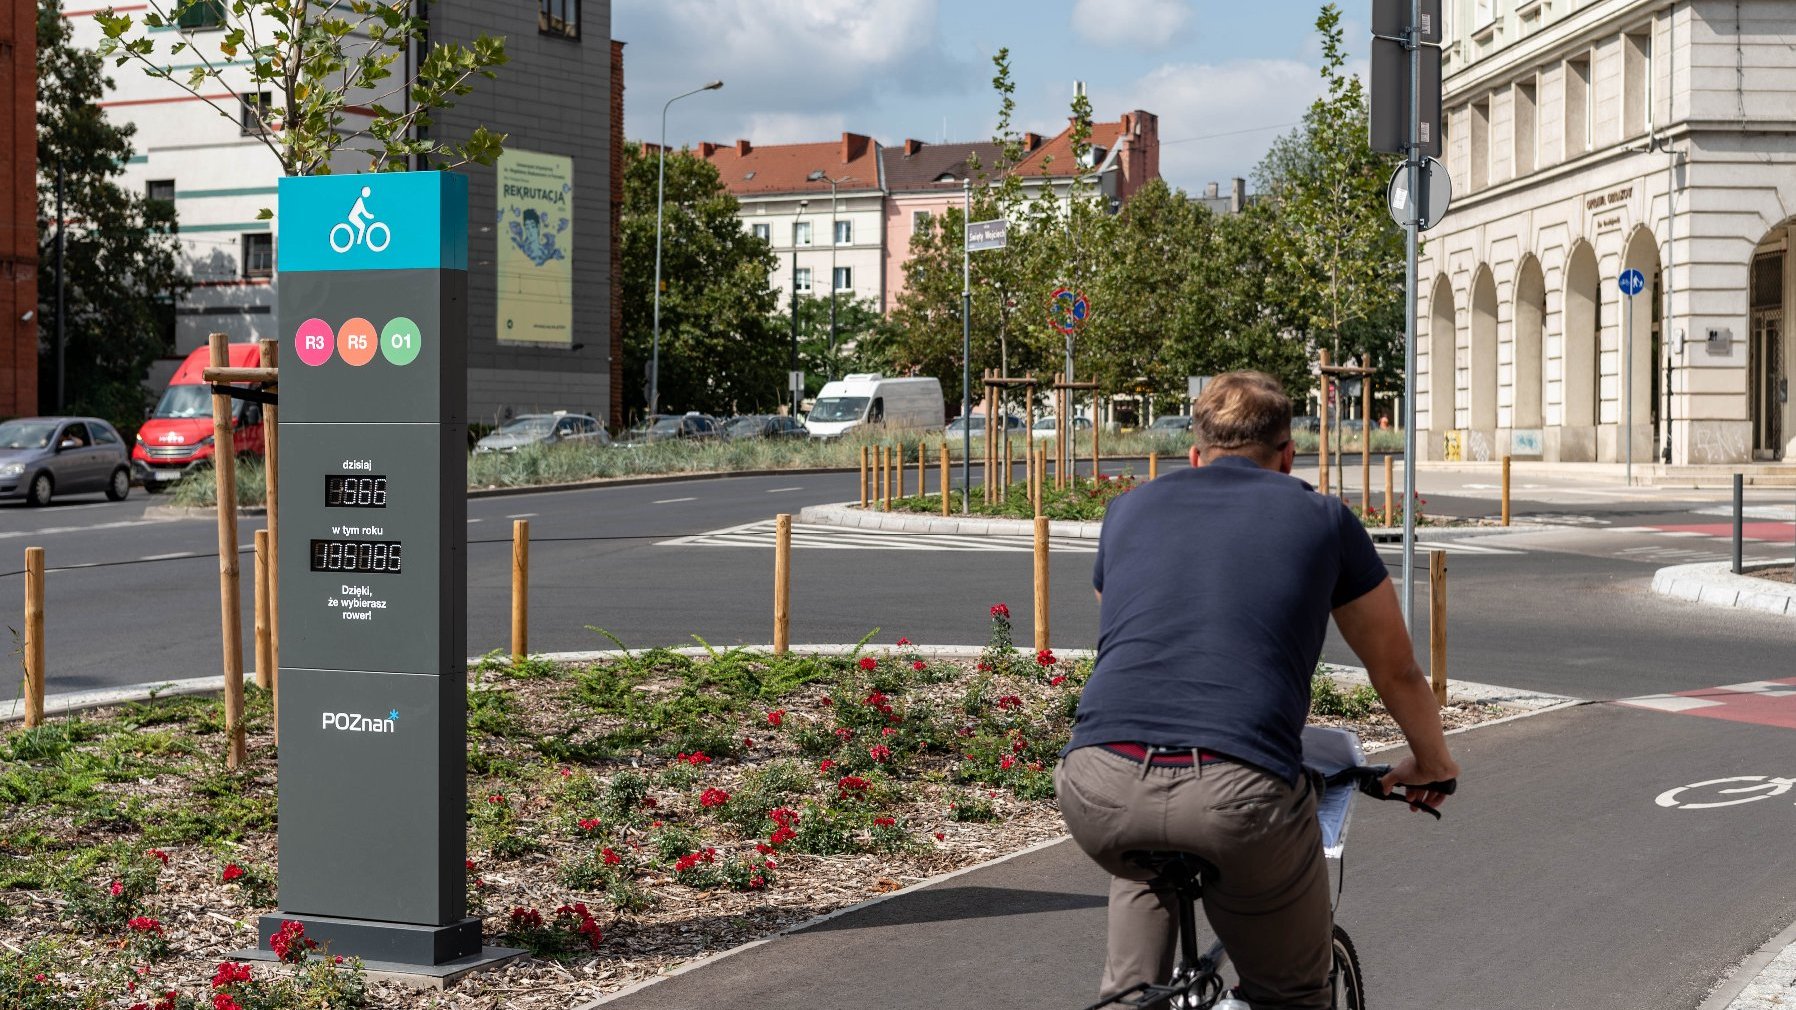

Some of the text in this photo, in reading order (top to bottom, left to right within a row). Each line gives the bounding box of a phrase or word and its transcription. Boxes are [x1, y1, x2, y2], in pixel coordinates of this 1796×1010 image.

[504, 184, 566, 205] REKRUTACJA
[305, 335, 325, 350] R3
[348, 334, 368, 350] R5
[342, 459, 372, 471] dzisiaj
[332, 525, 384, 537] w tym roku
[341, 585, 373, 598] Dzięki,
[328, 597, 387, 609] że wybierasz
[342, 610, 372, 621] rower!
